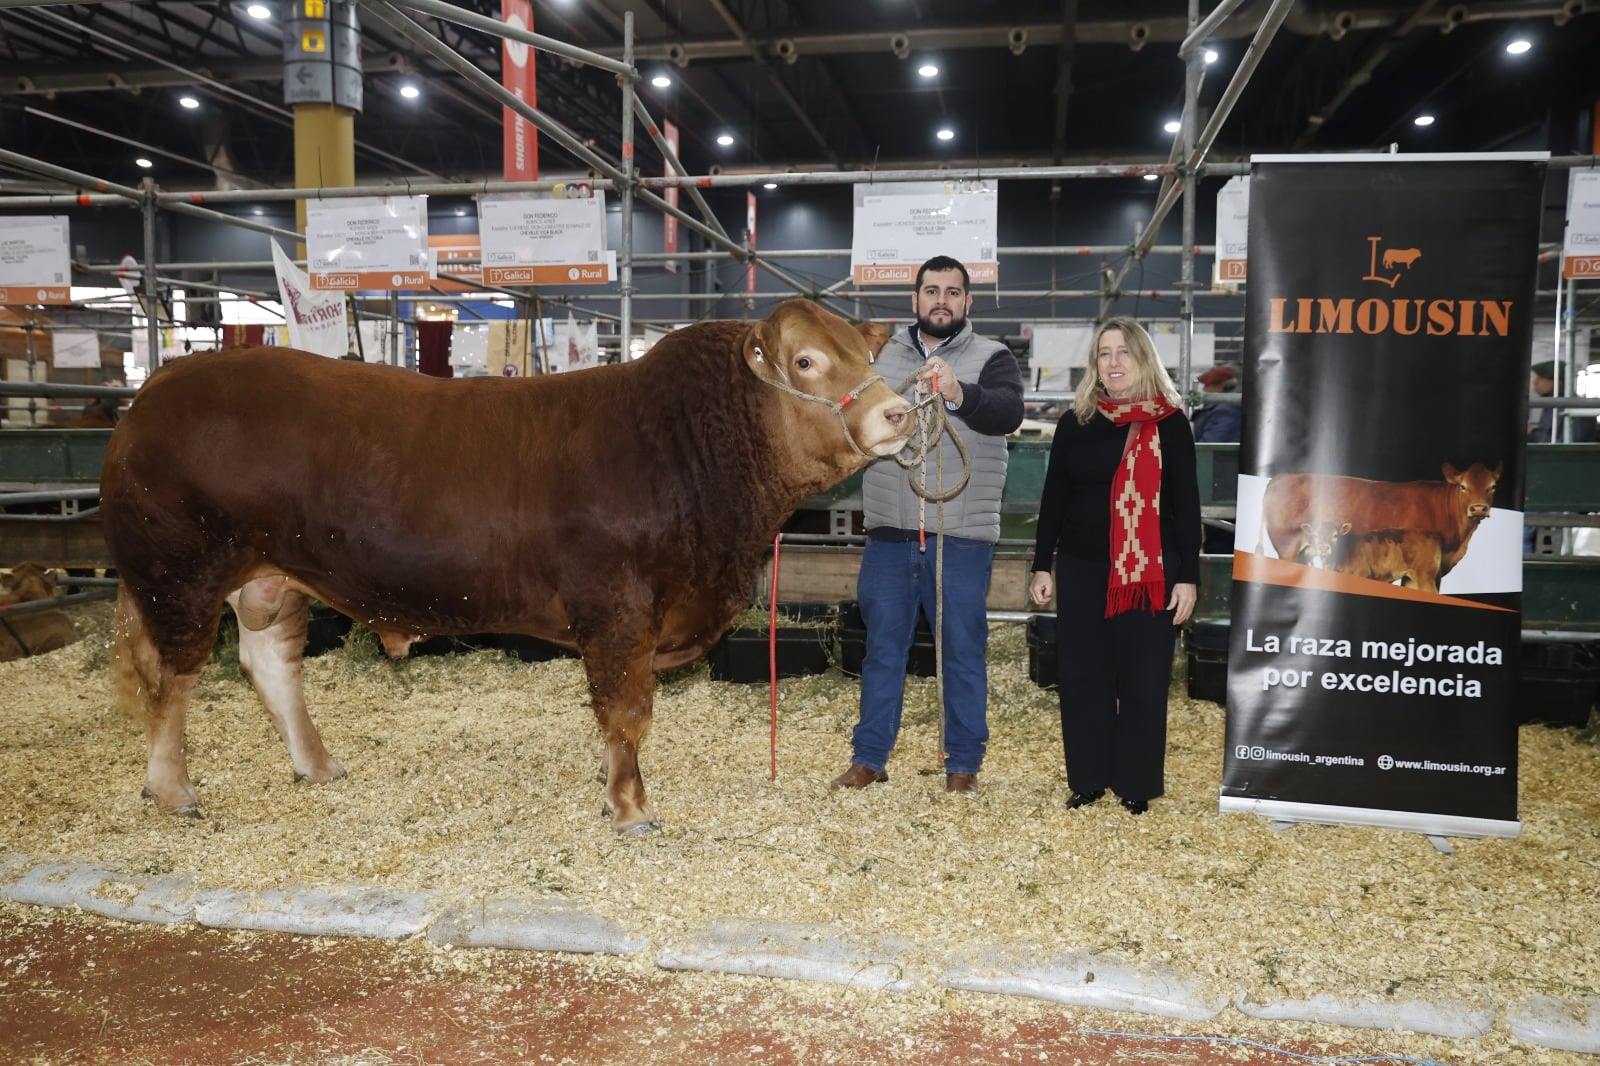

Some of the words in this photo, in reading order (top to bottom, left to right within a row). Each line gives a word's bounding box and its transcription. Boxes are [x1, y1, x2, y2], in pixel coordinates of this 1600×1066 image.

[514, 86, 525, 172] SHORTHN
[327, 275, 356, 287] Galicia
[404, 275, 424, 285] Rural
[503, 270, 531, 281] Galicia
[581, 269, 603, 279] Rural
[877, 269, 908, 280] Galicia
[1267, 297, 1513, 337] LIMOUSIN
[1246, 628, 1280, 653] La
[1290, 635, 1351, 658] raza
[1361, 637, 1502, 666] mejorada
[1263, 667, 1313, 691] por
[1321, 670, 1482, 697] excelencia
[1265, 750, 1364, 766] limousin_argentina
[1395, 760, 1506, 776] www.limousin.org.ar
